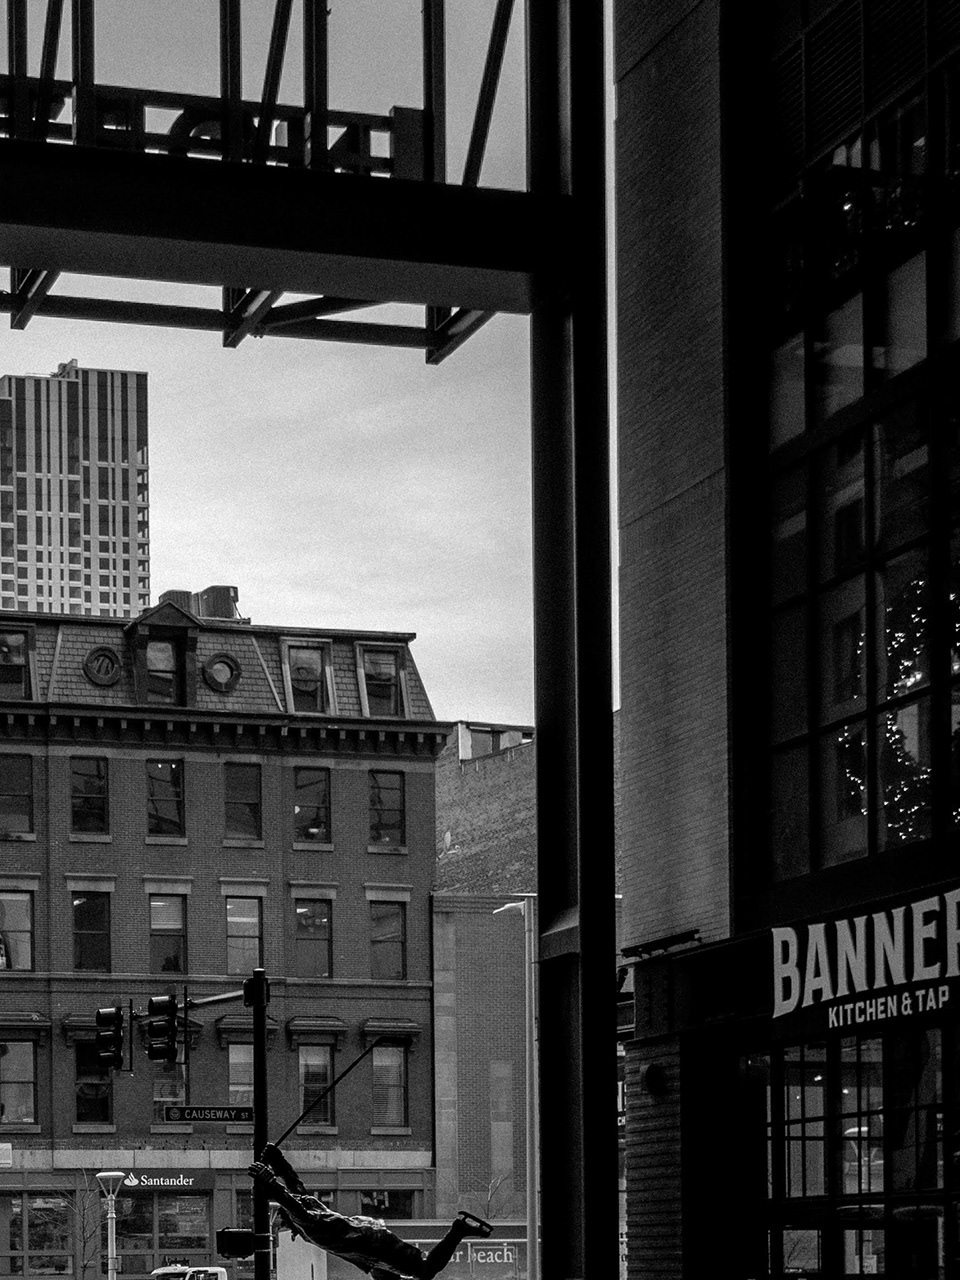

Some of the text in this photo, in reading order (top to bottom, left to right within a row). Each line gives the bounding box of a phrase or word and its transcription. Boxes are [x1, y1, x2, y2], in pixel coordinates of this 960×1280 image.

[828, 985, 950, 1028] KITCHEN & TAP
[184, 1109, 237, 1119] CAUSEWAY
[140, 1174, 195, 1186] Santander
[466, 1242, 514, 1263] beach
